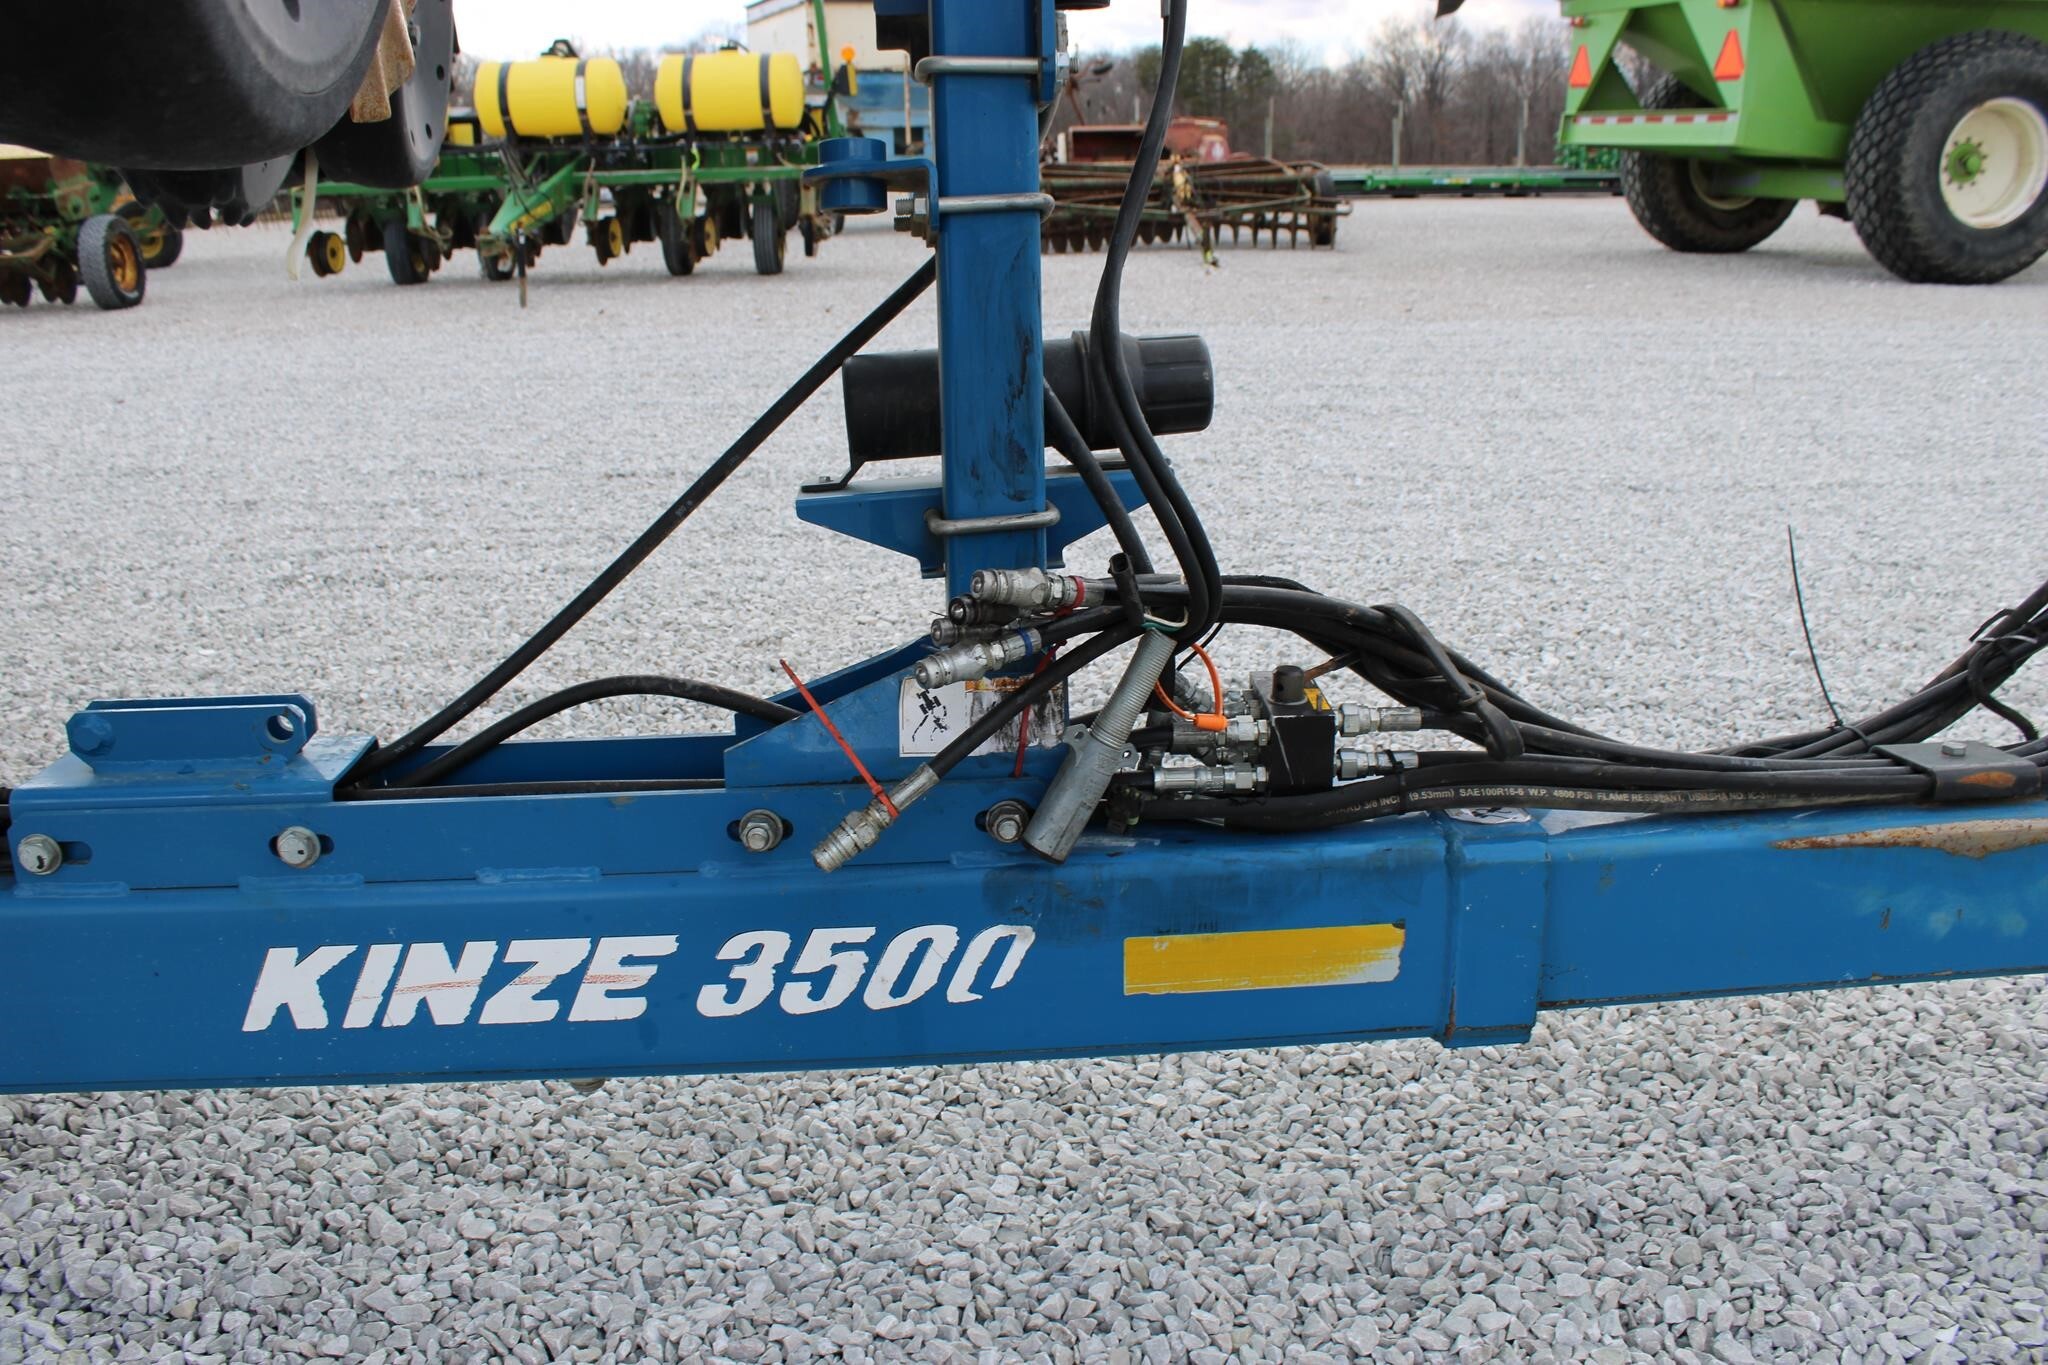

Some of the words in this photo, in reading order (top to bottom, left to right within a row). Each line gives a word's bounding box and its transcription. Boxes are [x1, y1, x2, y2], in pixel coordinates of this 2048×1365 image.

[1408, 788, 1456, 802] (9.53mm)
[1527, 787, 1550, 799] W.P.
[1576, 790, 1593, 800] PSI
[1597, 791, 1630, 802] FLAME
[242, 934, 679, 1033] KINZE
[696, 924, 1037, 1018] 3500
